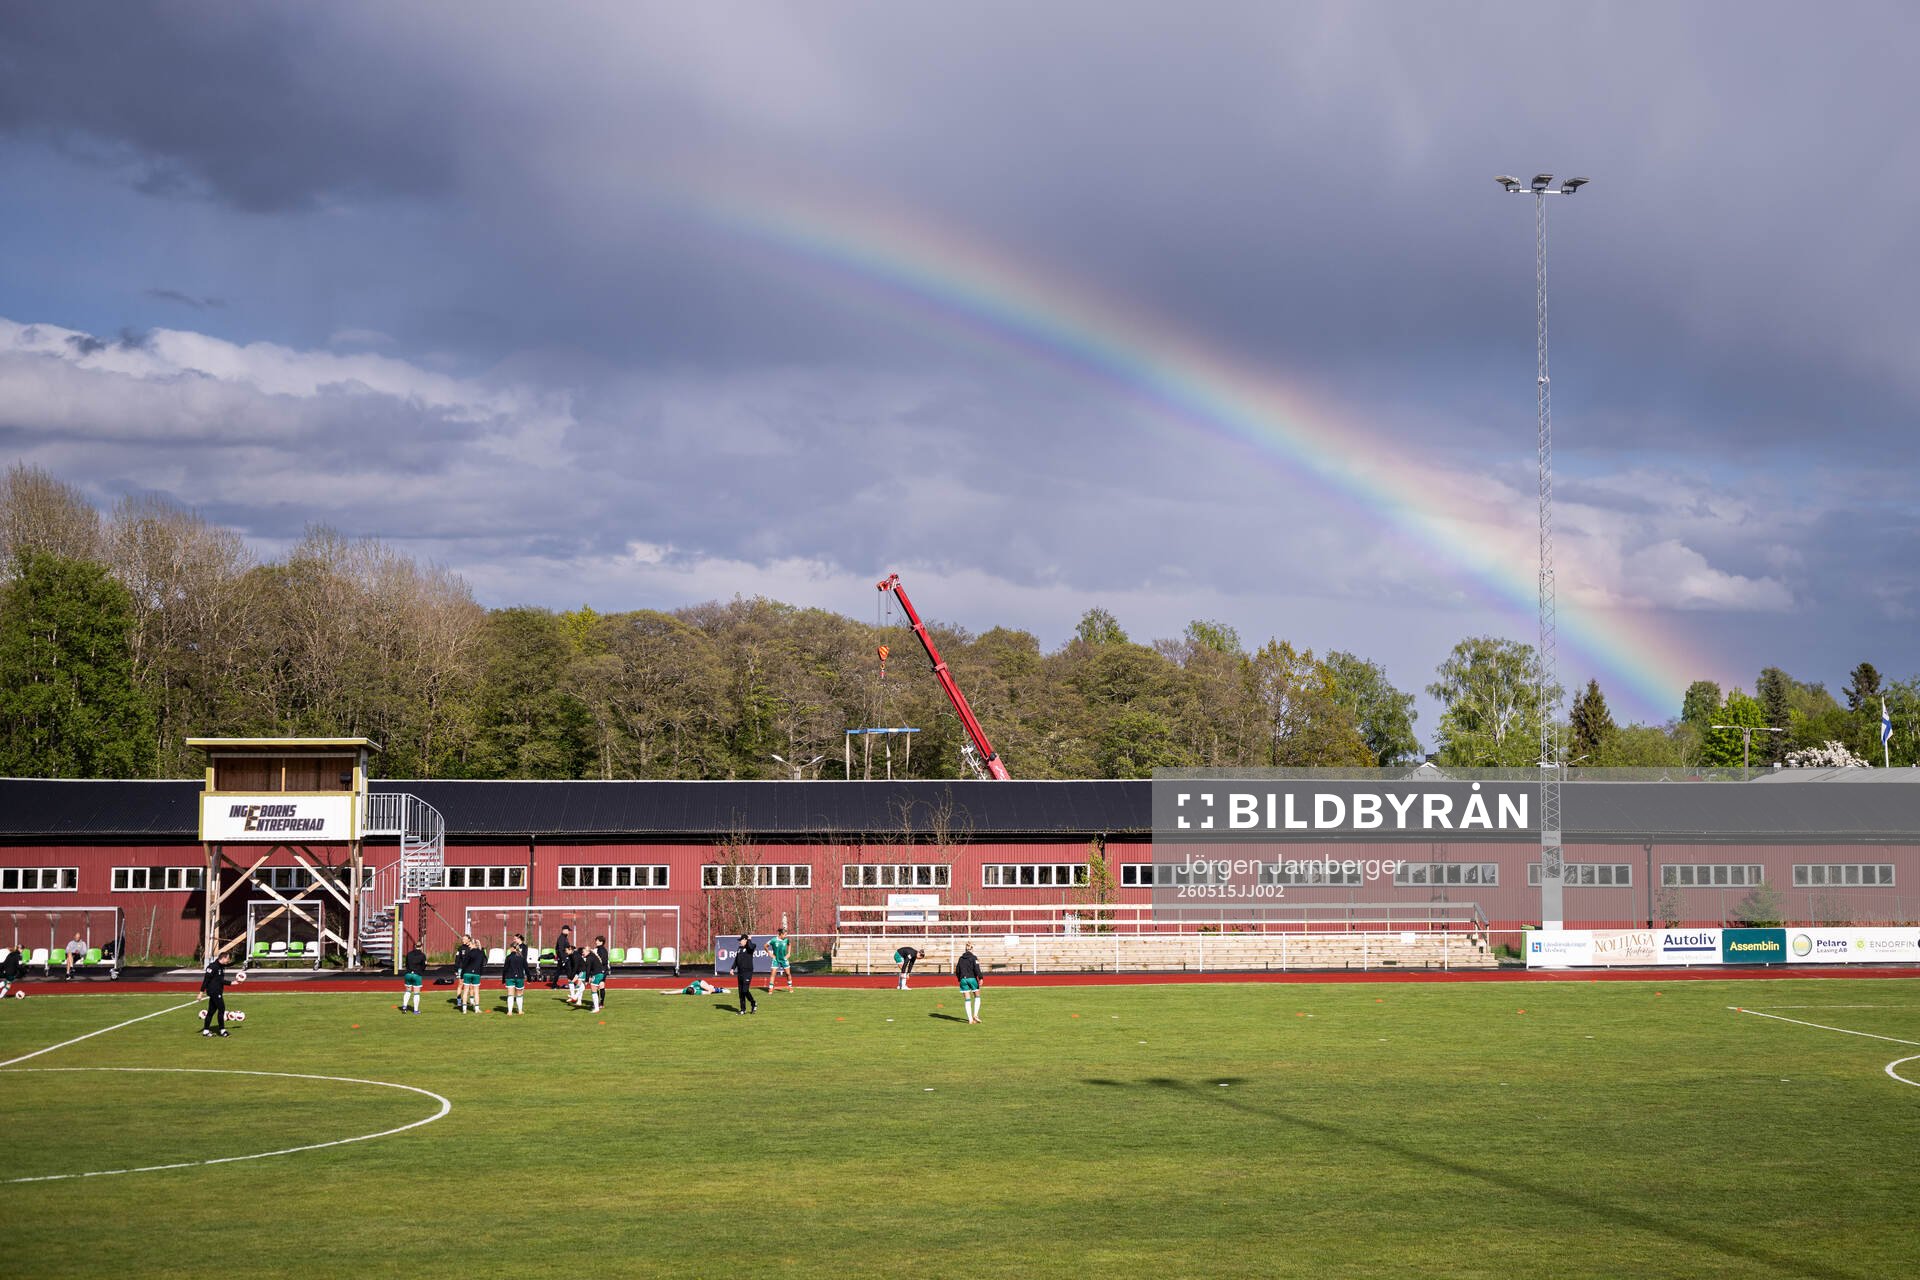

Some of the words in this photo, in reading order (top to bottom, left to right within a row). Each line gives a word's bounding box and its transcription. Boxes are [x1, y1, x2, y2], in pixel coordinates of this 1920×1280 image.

[229, 805, 297, 819] INGEBORNS
[244, 816, 325, 831] ENTREPRENAD
[1663, 933, 1716, 946] Autoliv
[1816, 939, 1847, 947] Pelaro
[1869, 940, 1915, 948] ENDORFIN
[1730, 940, 1780, 952] Assemblin
